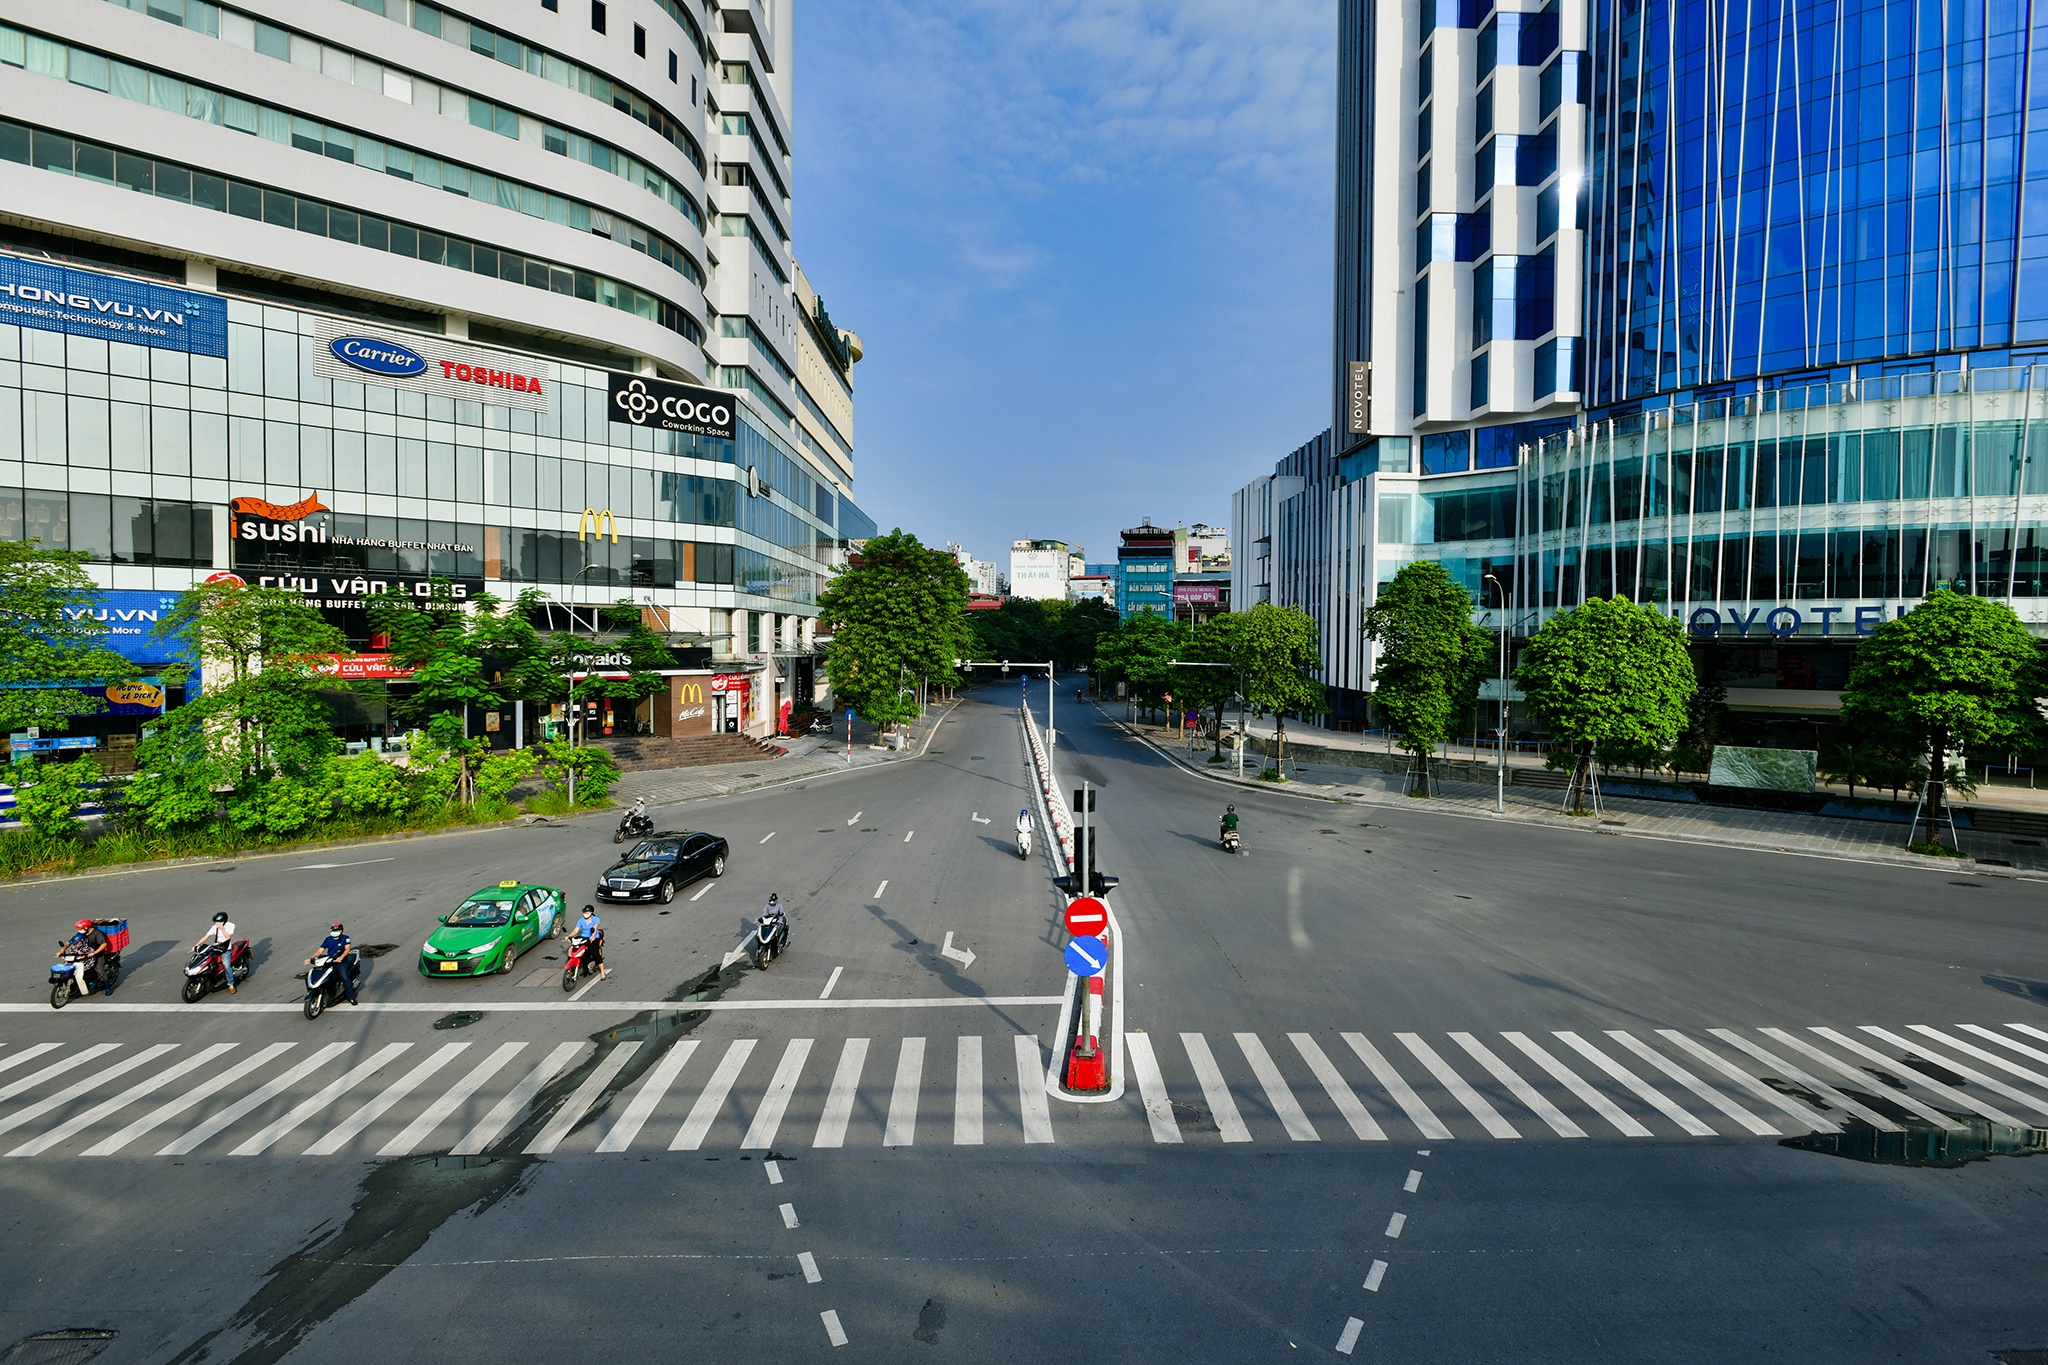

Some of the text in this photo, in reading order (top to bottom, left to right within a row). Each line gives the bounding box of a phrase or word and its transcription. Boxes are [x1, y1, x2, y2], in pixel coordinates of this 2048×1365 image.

[55, 310, 124, 331] Technology
[127, 322, 136, 331] &
[139, 325, 167, 336] More
[343, 341, 415, 368] Carrier
[439, 360, 543, 395] TOSHIBA
[1354, 366, 1364, 429] NOVOTEL
[661, 396, 730, 426] COGO
[662, 419, 730, 437] Coworking Space
[331, 534, 354, 546] NHÀ
[356, 536, 386, 548] HÀNG
[388, 540, 426, 550] BUFFET
[326, 600, 367, 609] BUFFET
[1203, 592, 1216, 600] 0%
[112, 627, 141, 635] More
[550, 653, 632, 666] conald's
